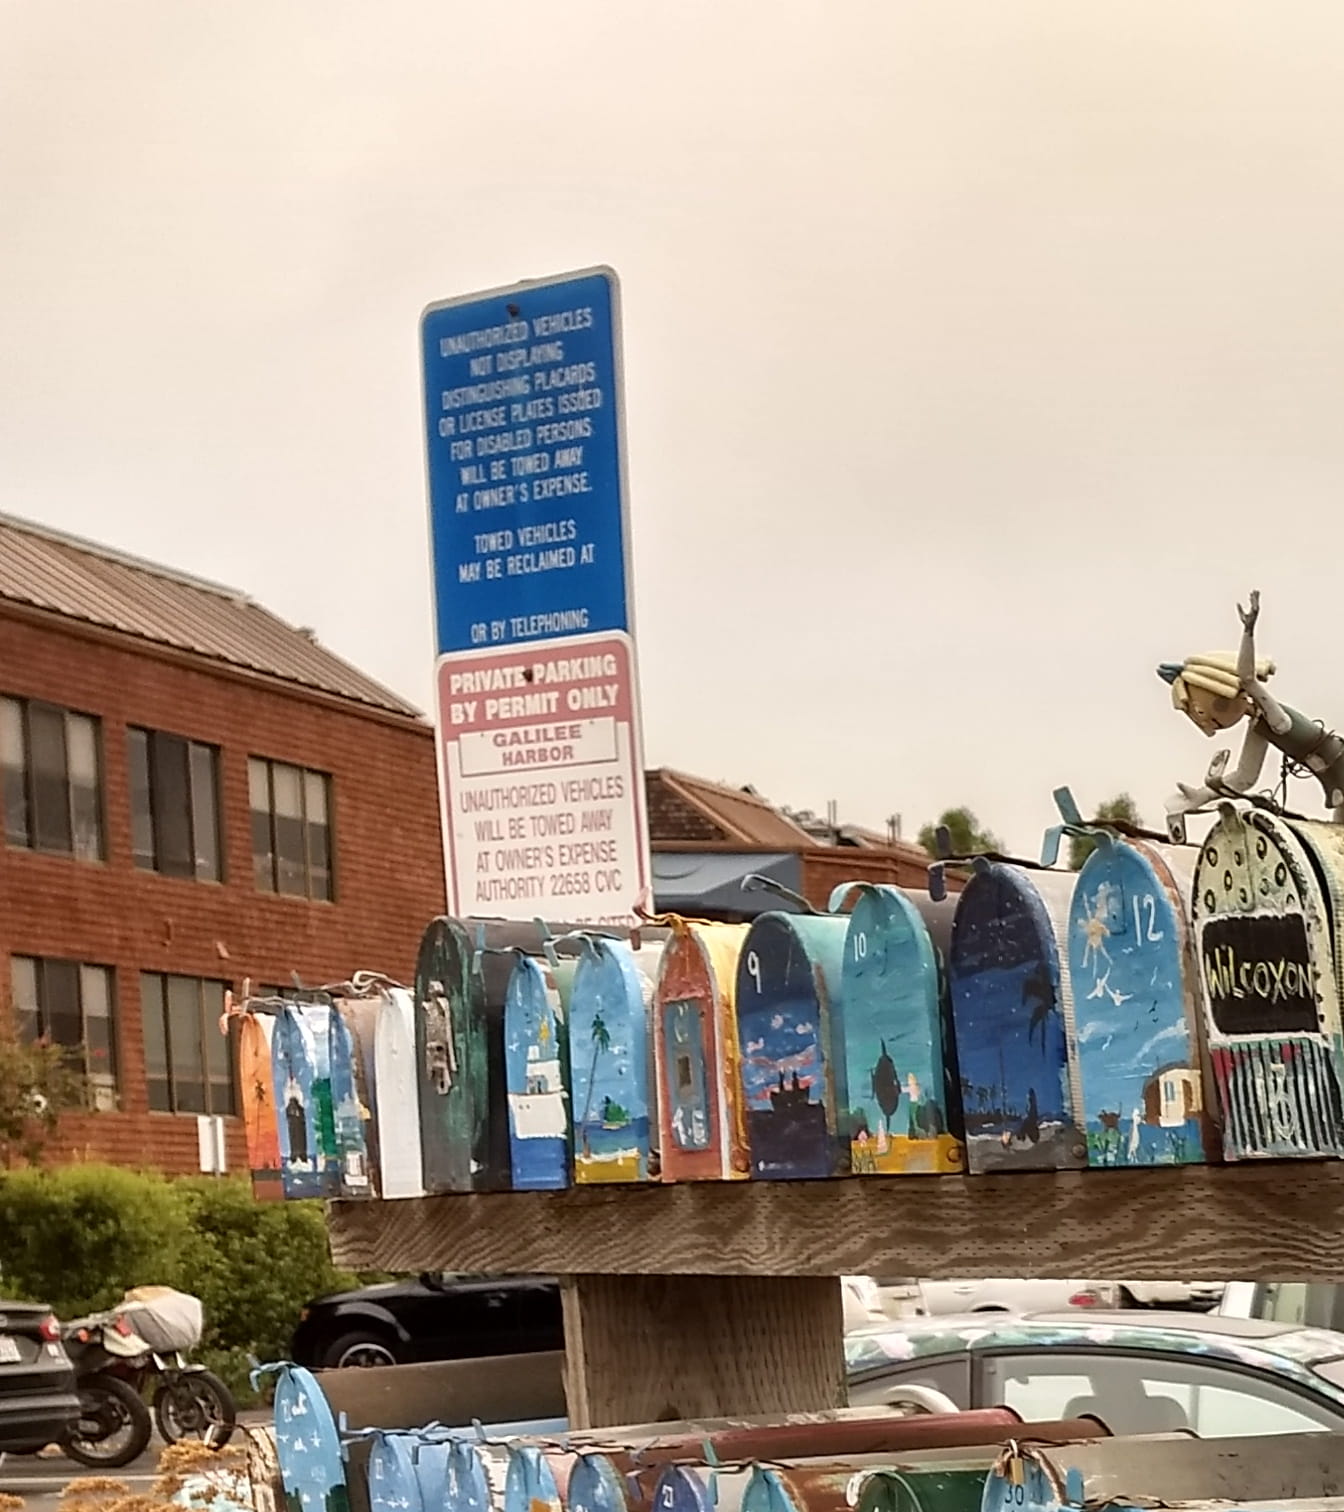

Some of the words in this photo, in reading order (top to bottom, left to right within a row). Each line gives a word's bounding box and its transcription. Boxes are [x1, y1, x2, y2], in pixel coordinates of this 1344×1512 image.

[440, 321, 528, 356] UNAUTHORIZED
[533, 308, 592, 336] VEHICLES
[470, 357, 493, 376] NOT
[496, 341, 563, 372] DISPLAYING
[442, 375, 531, 410] DISTINGUISHING
[535, 362, 595, 391] PLACARDS
[439, 417, 456, 437] OR
[459, 407, 506, 433] LICENSE
[511, 398, 554, 422] PLATES
[557, 389, 602, 414] ISSUED
[450, 442, 473, 460] FOR
[477, 431, 531, 458] DISABLED
[537, 418, 592, 444] PERSONS
[460, 466, 486, 485] WILL
[491, 460, 506, 480] BE
[511, 452, 549, 475] TOWED
[554, 447, 583, 468] AWAY
[456, 493, 469, 513] AT
[473, 482, 528, 509] OWNER'S
[533, 473, 592, 499] EXPENSE.
[474, 531, 513, 553] TOWED
[517, 520, 576, 547] VEHICLES
[459, 563, 481, 583] MAY
[486, 560, 502, 579] BE
[507, 548, 575, 576] RECLAIMED
[581, 544, 594, 563] AT
[471, 623, 487, 643] OR
[492, 620, 505, 640] BY
[510, 608, 589, 637] TELEPHONING
[451, 667, 526, 695] PRIVATE
[533, 655, 616, 685] PARKING
[451, 702, 477, 724] BY
[486, 692, 560, 720] PERMIT
[568, 684, 618, 710] ONLY
[493, 724, 582, 747] GALILEE
[503, 746, 574, 766] HARBOR
[460, 784, 555, 813] UNAUTHORIZED
[561, 776, 624, 801] VEHICLES
[474, 819, 504, 841] WILL
[509, 818, 526, 839] BE
[530, 813, 575, 837] TOWED
[580, 809, 613, 832] AWAY
[477, 852, 490, 872] AT
[496, 846, 553, 871] OWNER'S
[560, 840, 617, 865] EXPENSE
[476, 876, 545, 901] AUTHORITY
[550, 873, 590, 896] 22658
[595, 870, 622, 892] CVC
[1133, 894, 1164, 946] 12
[853, 932, 867, 962] 10
[747, 951, 762, 994] 9
[1004, 1484, 1024, 1506] 30
